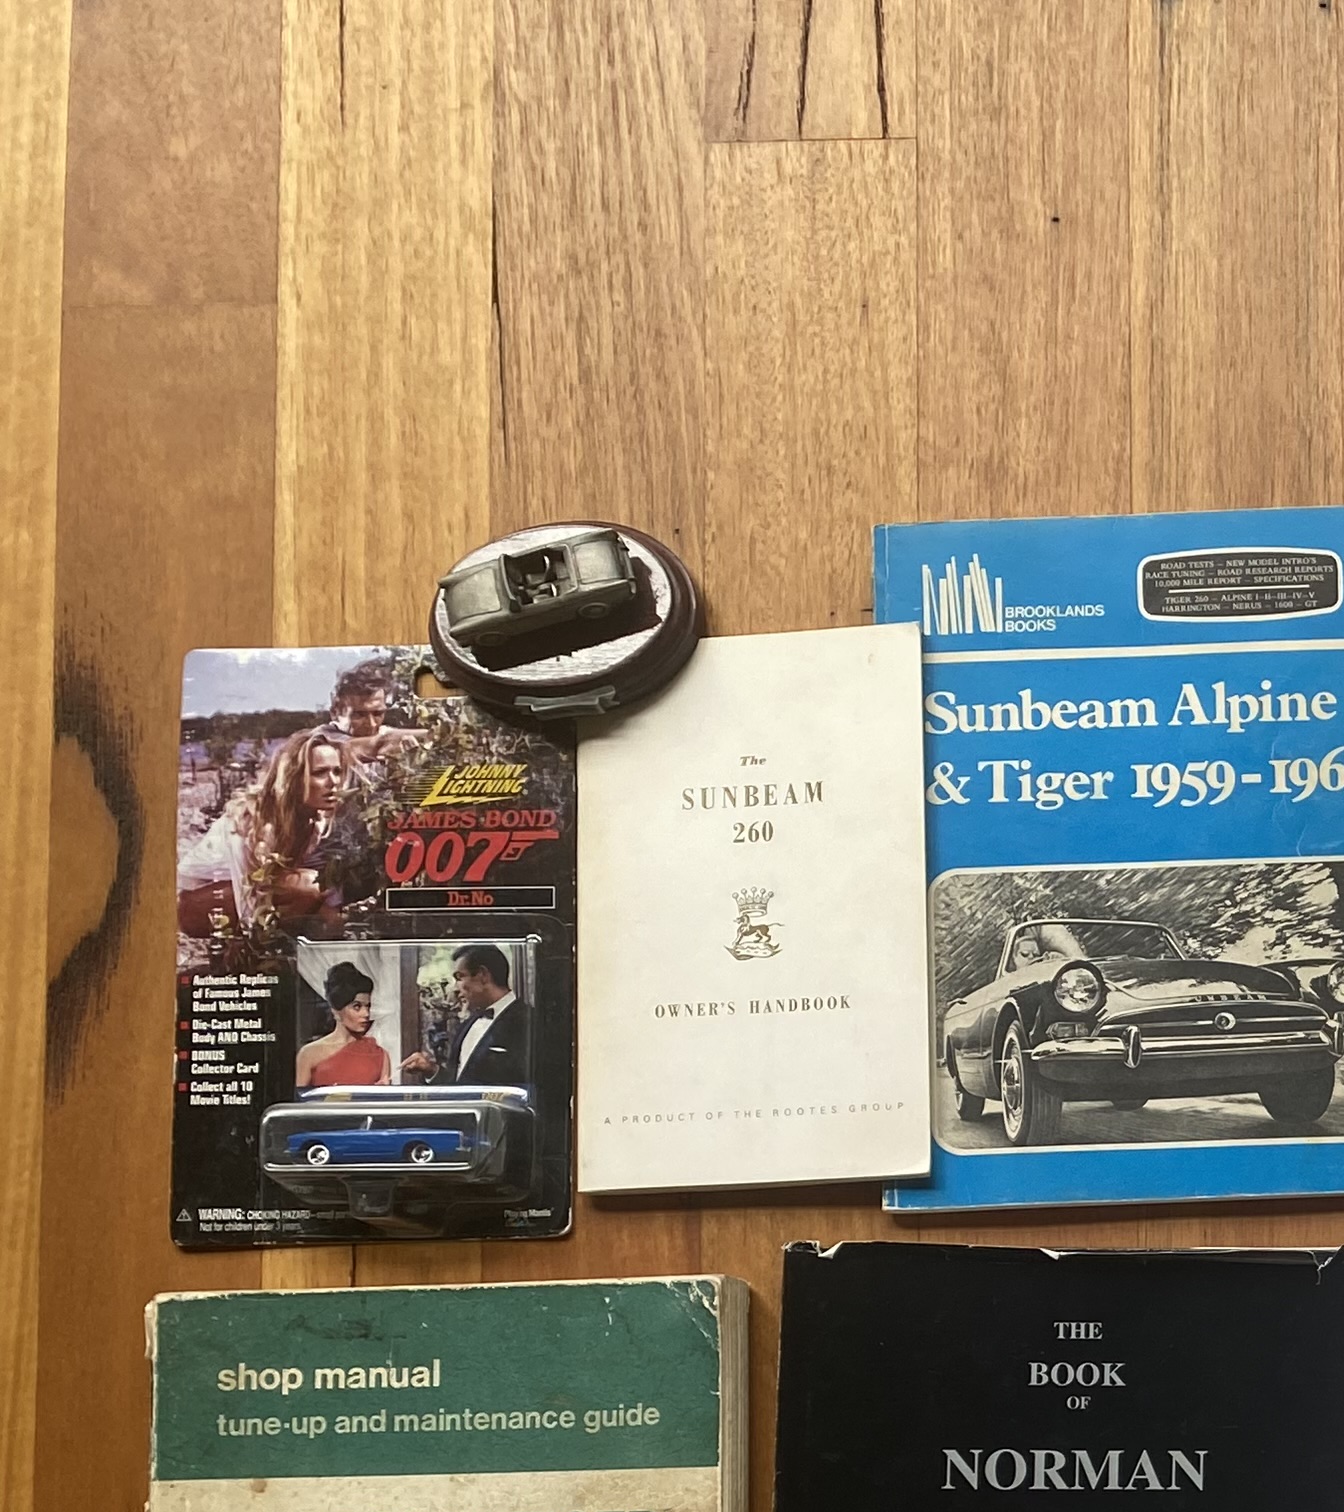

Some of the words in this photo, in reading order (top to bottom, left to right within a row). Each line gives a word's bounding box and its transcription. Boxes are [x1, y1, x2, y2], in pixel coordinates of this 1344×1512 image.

[1005, 605, 1104, 619] BROOKLANDS
[1005, 619, 1056, 632] BOOKS
[925, 689, 1158, 734] Sunbeam
[1168, 680, 1336, 734] Alpine
[454, 764, 526, 782] JOHNNY
[740, 756, 766, 767] The
[422, 769, 529, 806] LIGHTNING
[681, 782, 826, 812] SUNBEAM
[926, 762, 970, 805] &
[977, 759, 1114, 810] Tiger
[388, 811, 478, 829] JAMES
[484, 809, 557, 829] BOND
[732, 821, 775, 844] 260
[385, 830, 559, 882] 007
[654, 1000, 738, 1019] OWNER'S
[749, 995, 851, 1014] HANDBOOK
[1054, 1322, 1103, 1339] THE
[217, 1363, 303, 1395] shop
[314, 1360, 440, 1390] manual
[1028, 1362, 1126, 1388] BOOK
[1066, 1396, 1091, 1410] OF
[335, 1411, 386, 1434] and
[394, 1406, 576, 1432] maintenance
[584, 1404, 661, 1433] guide
[942, 1449, 1208, 1492] NORMAN
